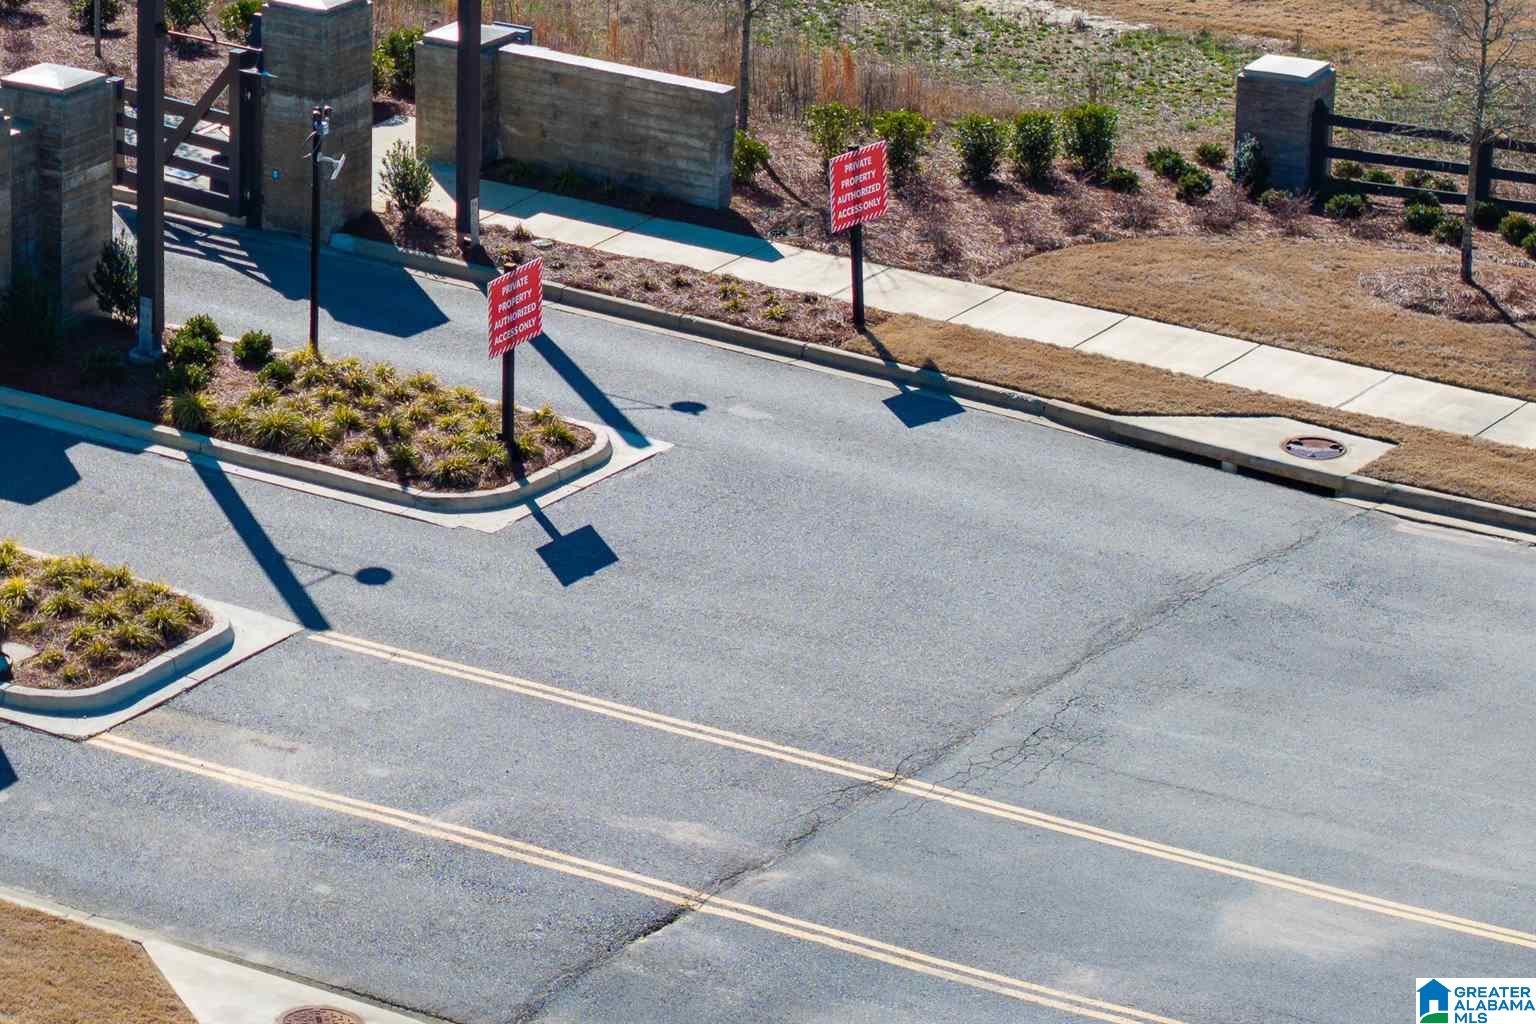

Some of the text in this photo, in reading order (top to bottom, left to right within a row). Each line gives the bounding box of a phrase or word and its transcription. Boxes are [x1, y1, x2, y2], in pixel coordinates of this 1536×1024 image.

[844, 157, 872, 173] PRIVATE
[841, 170, 876, 189] PROPERTY
[837, 183, 880, 204] AUTHORIZED
[837, 197, 881, 219] ACCESS ONLY
[502, 276, 528, 295] PRIVATE
[498, 289, 532, 312] PROPERTY
[494, 302, 536, 329] AUTHORIZED
[494, 317, 536, 345] ACCESS ONLY
